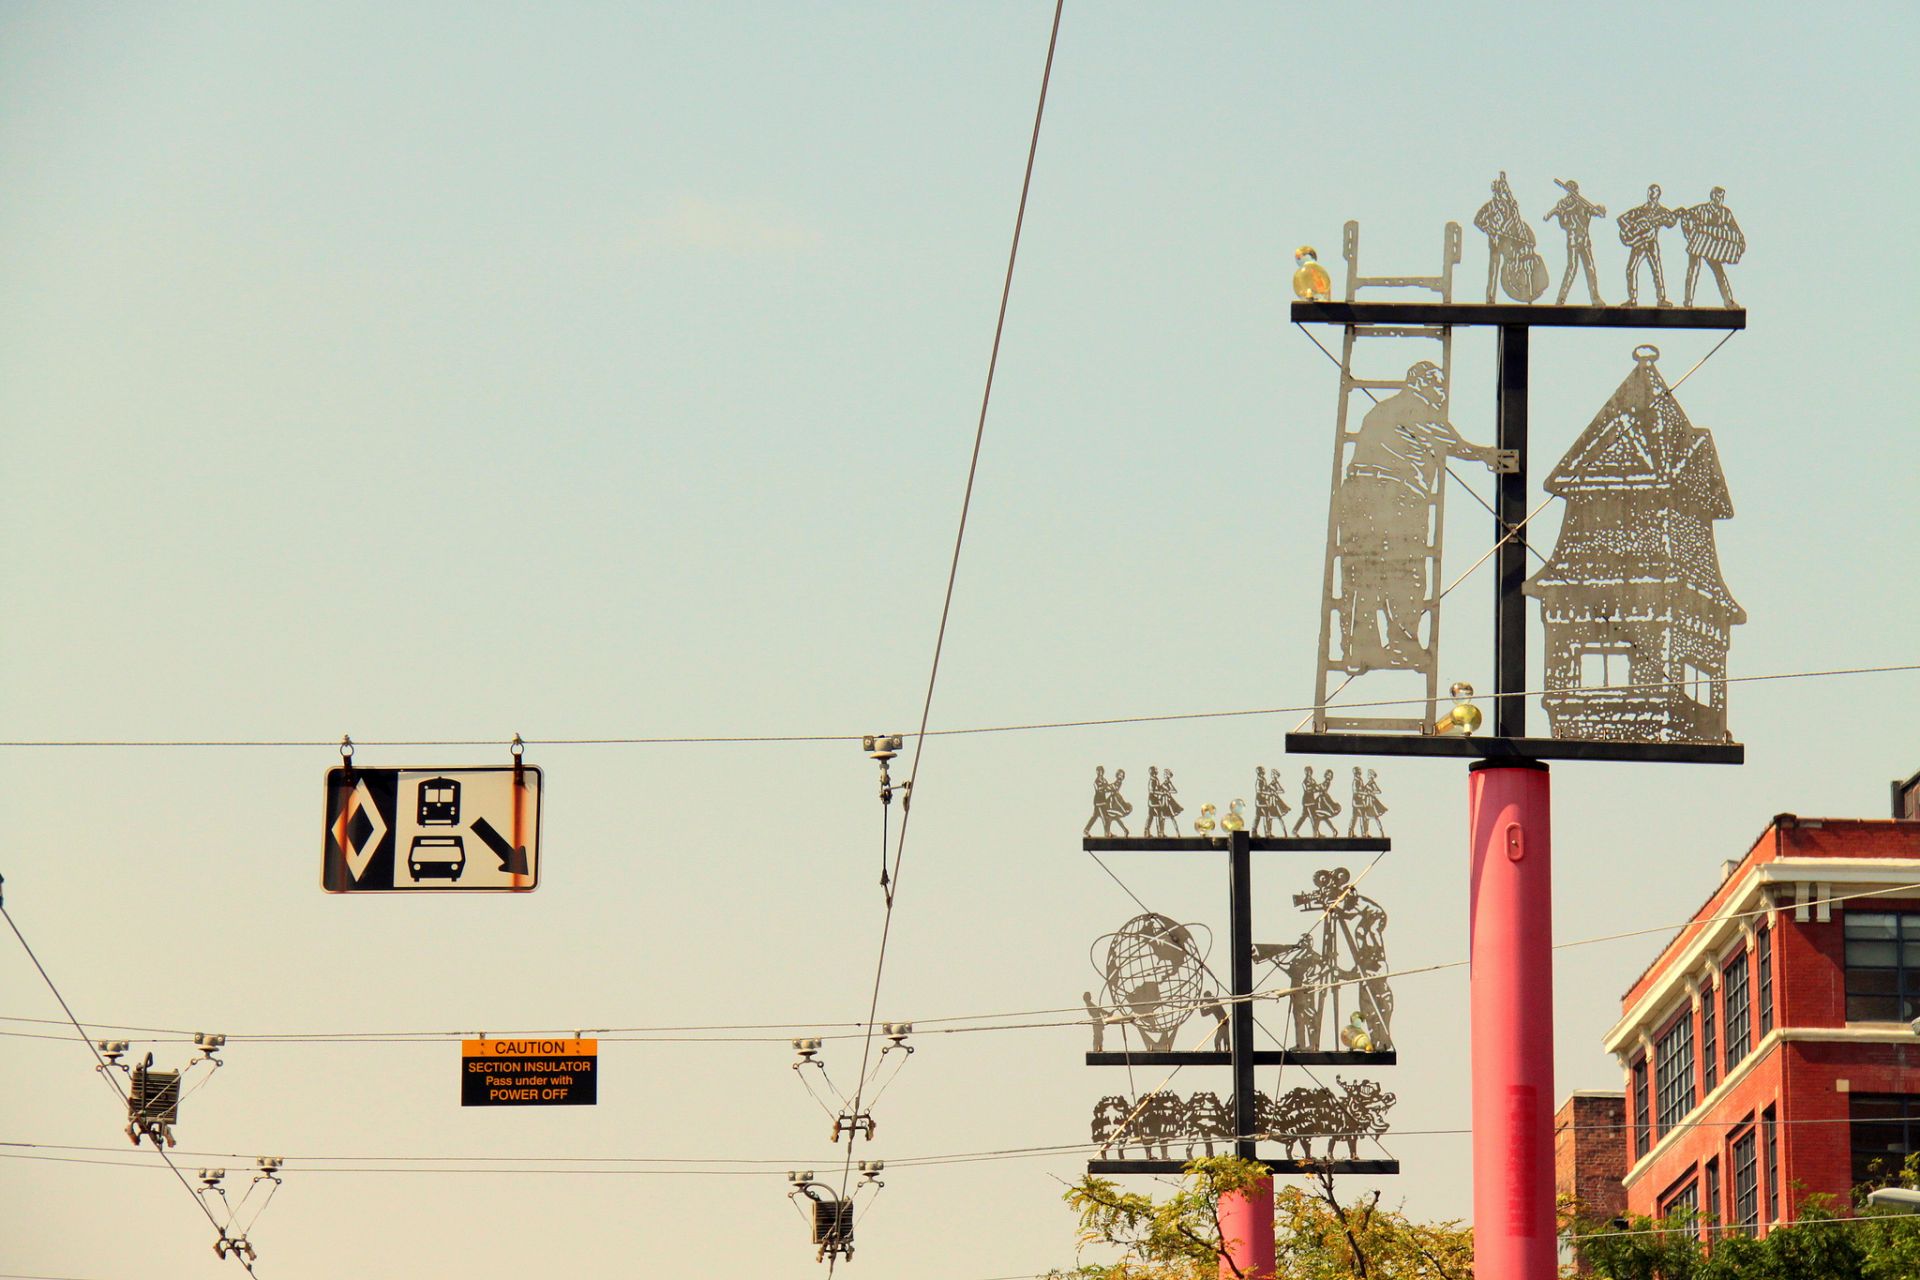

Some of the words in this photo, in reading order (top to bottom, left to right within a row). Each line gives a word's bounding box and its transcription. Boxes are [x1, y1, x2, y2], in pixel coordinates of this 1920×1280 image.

[495, 1041, 565, 1054] CAUTION
[468, 1062, 521, 1073] SECTION
[524, 1061, 591, 1072] INSULATOR
[486, 1076, 512, 1086] Pass
[515, 1075, 548, 1085] under
[550, 1075, 573, 1085] with
[490, 1089, 538, 1100] POWER
[542, 1088, 568, 1100] OFF
